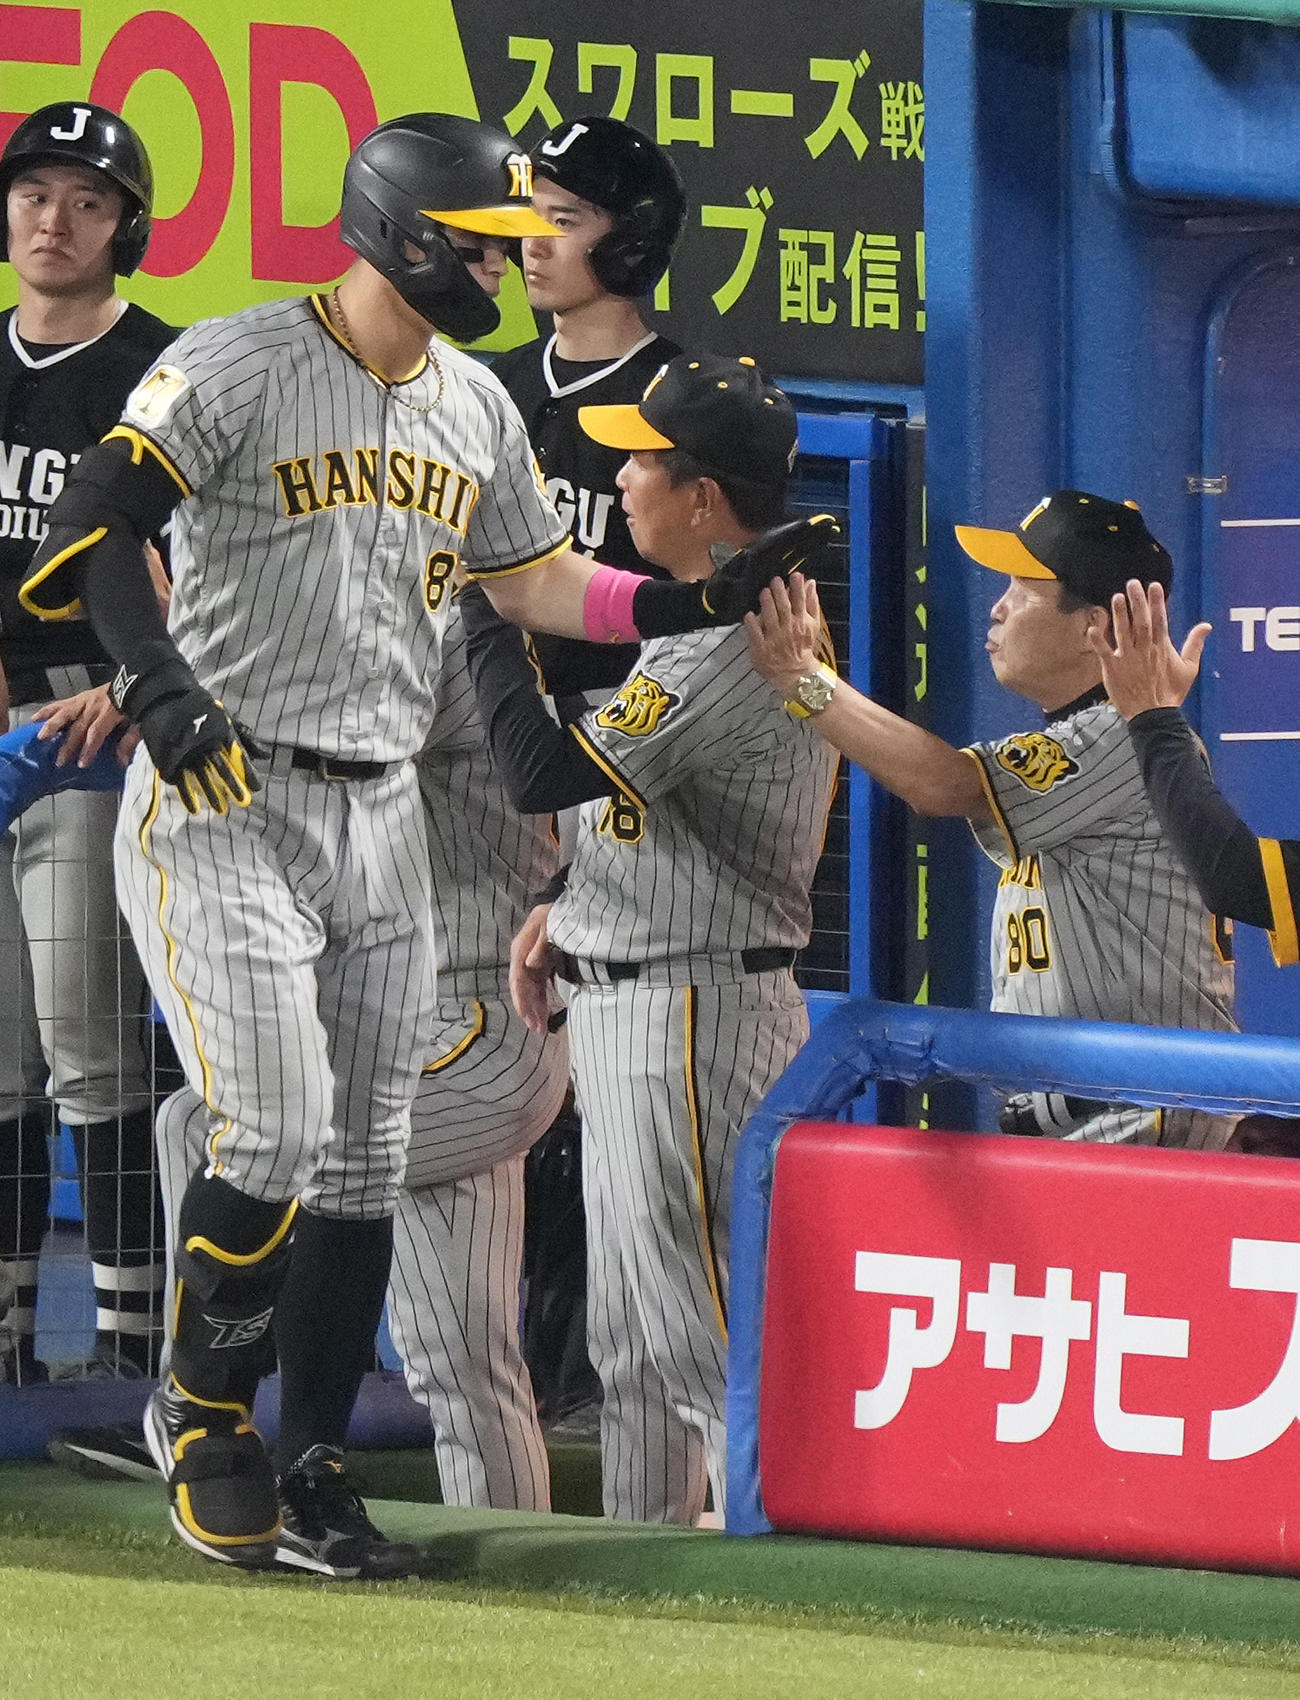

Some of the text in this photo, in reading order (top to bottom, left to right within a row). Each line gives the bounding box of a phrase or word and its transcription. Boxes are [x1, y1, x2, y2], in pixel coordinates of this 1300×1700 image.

[49, 107, 92, 141] J
[541, 122, 590, 156] J
[0, 440, 82, 505] NG
[424, 550, 458, 613] 8
[1007, 905, 1052, 976] 80
